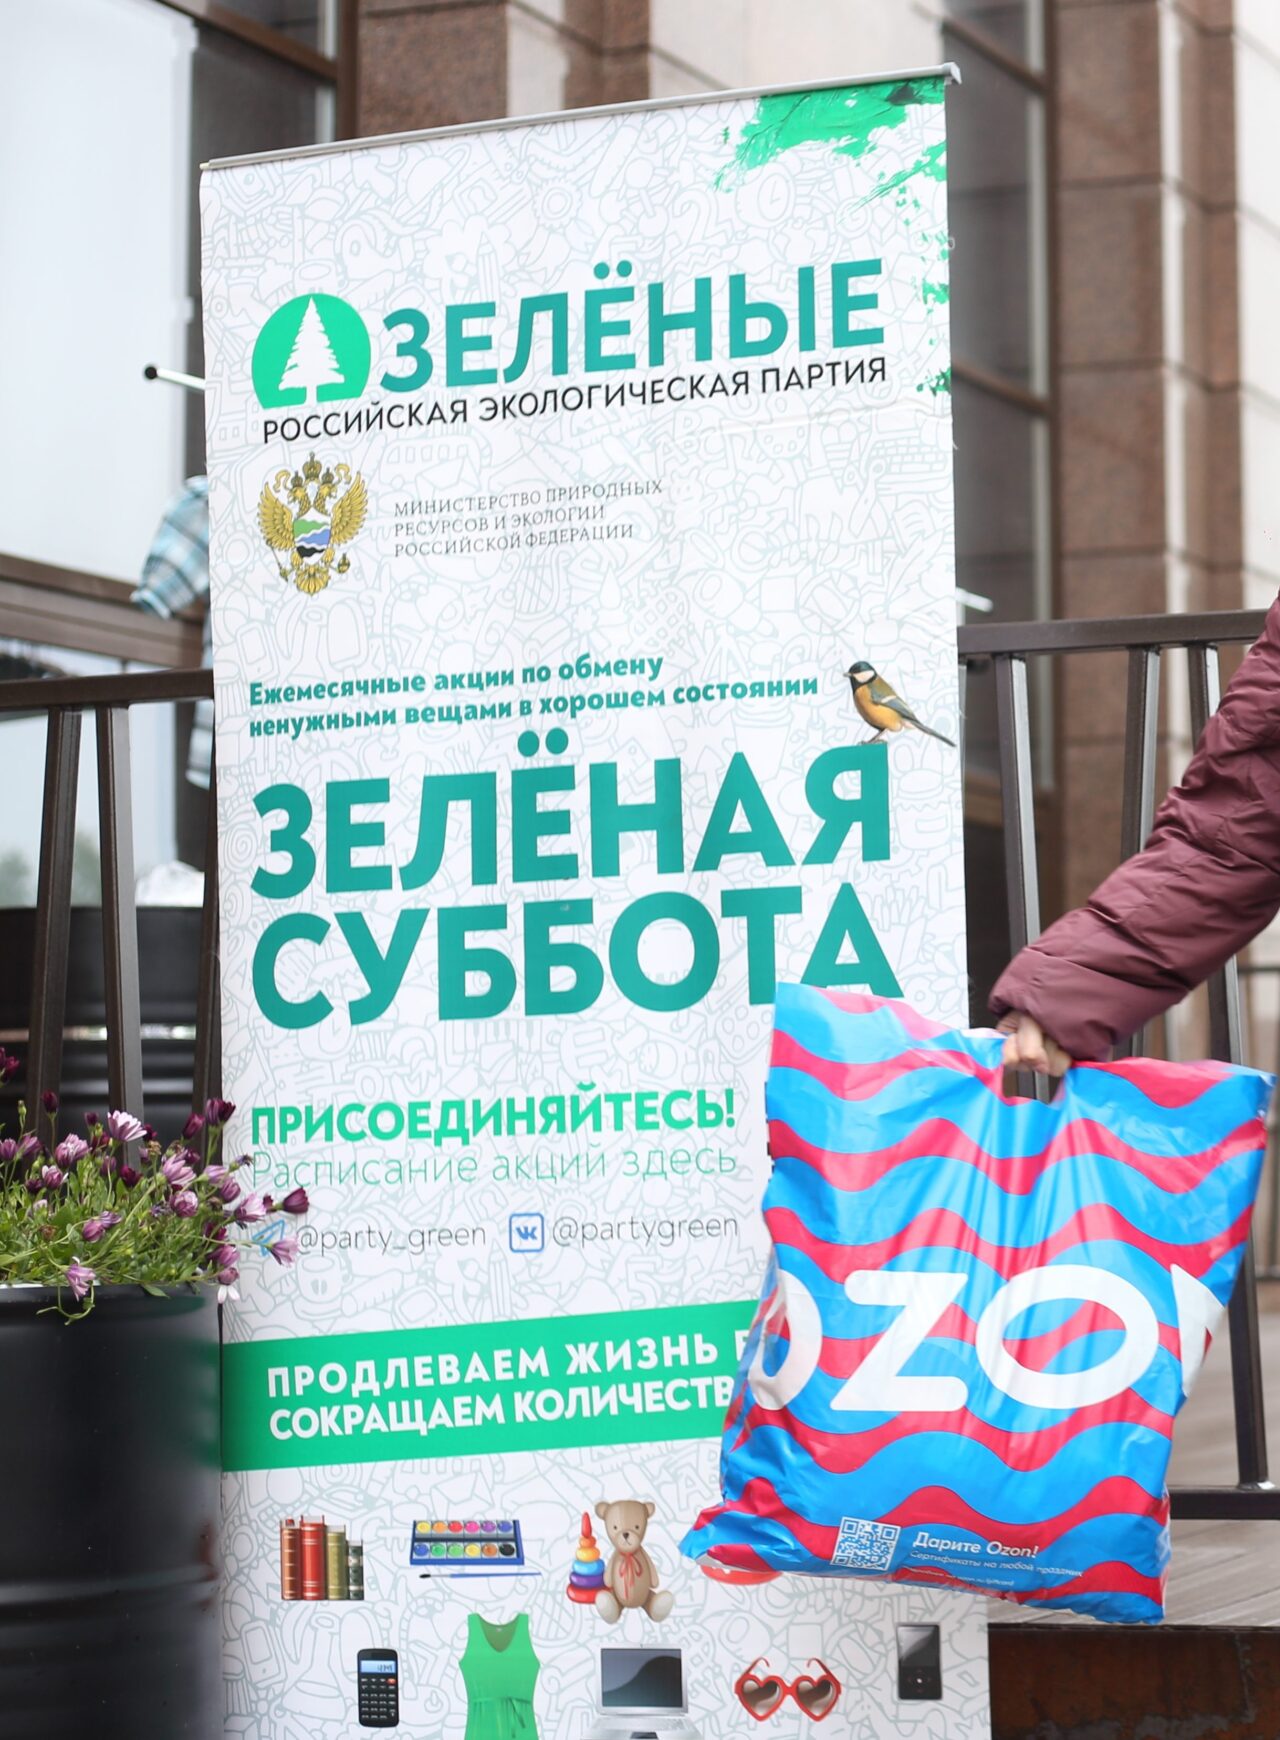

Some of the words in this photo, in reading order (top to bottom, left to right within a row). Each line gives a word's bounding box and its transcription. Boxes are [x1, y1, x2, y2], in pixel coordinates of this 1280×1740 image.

[379, 260, 886, 392] ЗЕЛЁНЫЕ
[263, 399, 468, 444] РОССИЙСКАЯ
[479, 371, 749, 421] ЭКОЛОГИЧЕСКАЯ
[761, 357, 886, 393] ПАРТИЯ
[394, 490, 541, 517] МИНИСТЕРСТВО
[546, 480, 663, 502] ПРИРОДНЫХ
[394, 517, 489, 537] РЕСУРСОВ
[494, 516, 506, 530] И
[511, 505, 605, 529] ЭКОЛОГИИ
[394, 531, 521, 557] РОССИЙСКОЙ
[525, 524, 633, 548] ФЕДЕРАЦИИ
[250, 674, 426, 706] Ежемесячные
[434, 669, 514, 692] акции
[522, 665, 551, 684] по
[558, 652, 664, 681] обмену
[250, 707, 397, 740] ненужными
[405, 701, 512, 724] вещами
[519, 699, 532, 716] в
[539, 688, 666, 718] хорошем
[673, 677, 818, 703] состоянии
[250, 728, 891, 899] ЗЕЛЁНАЯ
[251, 882, 904, 1031] СУББОТА
[252, 1081, 735, 1147] ПРИСОЕДИНЯЙТЕСЬ!
[253, 1151, 477, 1188] Расписание
[492, 1142, 605, 1184] акций
[623, 1147, 736, 1182] здесь
[297, 1225, 486, 1257] @party_green
[552, 1216, 738, 1248] @partygreen
[267, 1346, 550, 1398] ПРОДЛЕВАЕМ
[565, 1333, 718, 1375] ЖИЗНЬ
[269, 1393, 505, 1440] СОКРАЩАЕМ
[514, 1375, 735, 1423] КОЛИЧЕСТВ
[910, 1550, 981, 1568] Сертификаты
[983, 1560, 997, 1569] на
[912, 1531, 981, 1554] Дарите
[986, 1541, 1039, 1559] Ozon!
